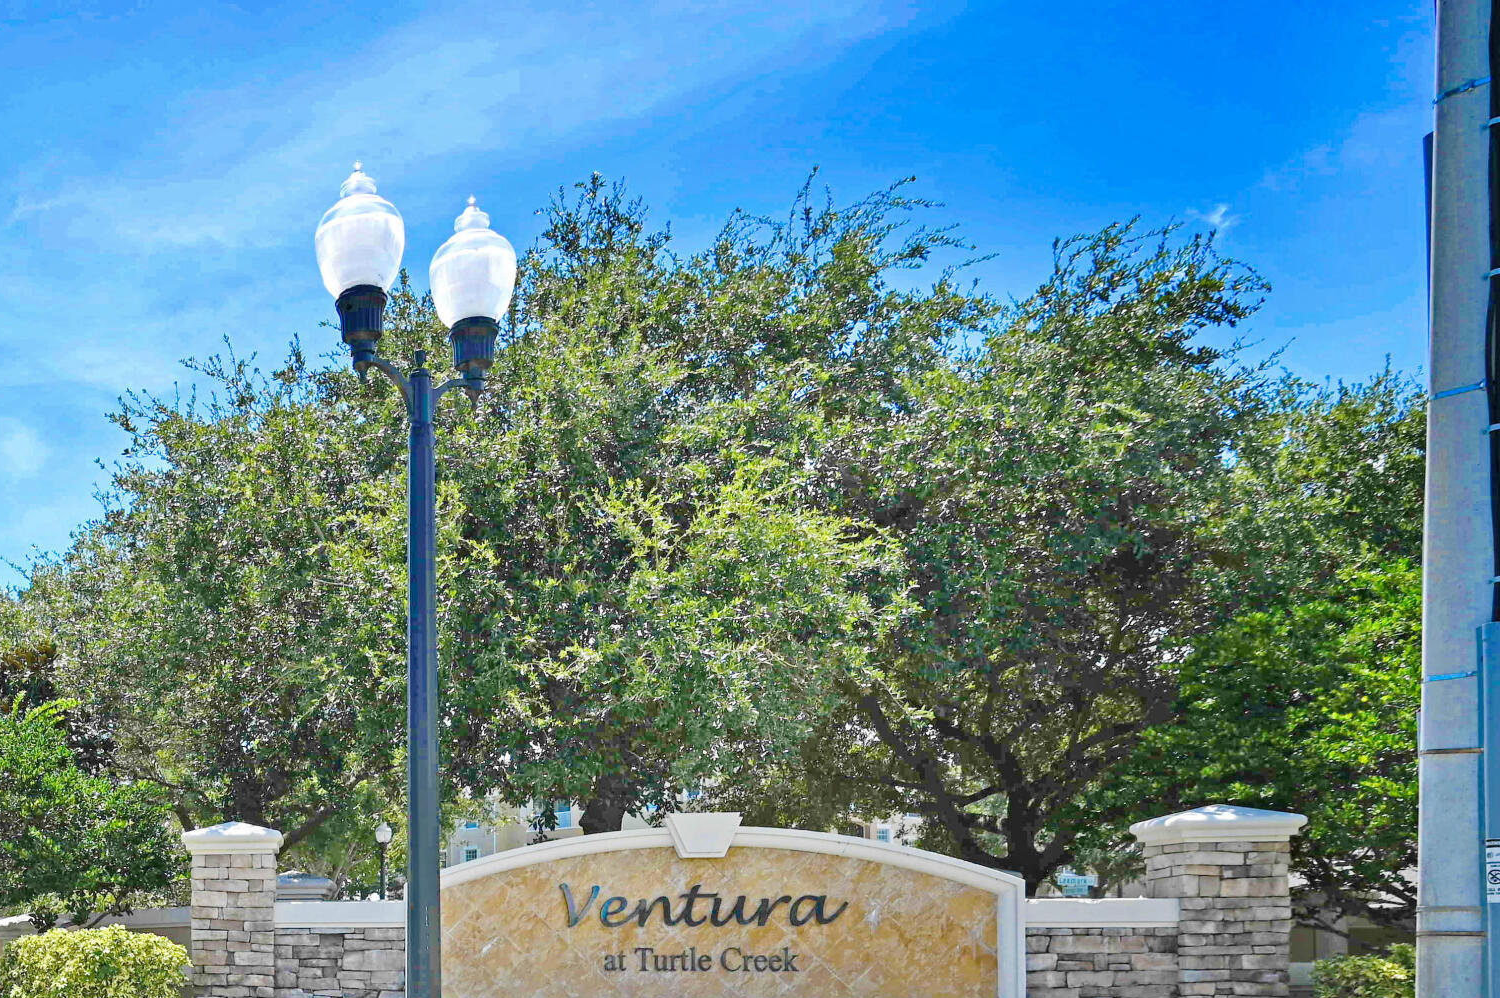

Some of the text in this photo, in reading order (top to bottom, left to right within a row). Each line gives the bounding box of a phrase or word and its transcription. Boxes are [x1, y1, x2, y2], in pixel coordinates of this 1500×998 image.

[559, 883, 849, 928] Ventura
[603, 948, 799, 972] at Turtle Creek
